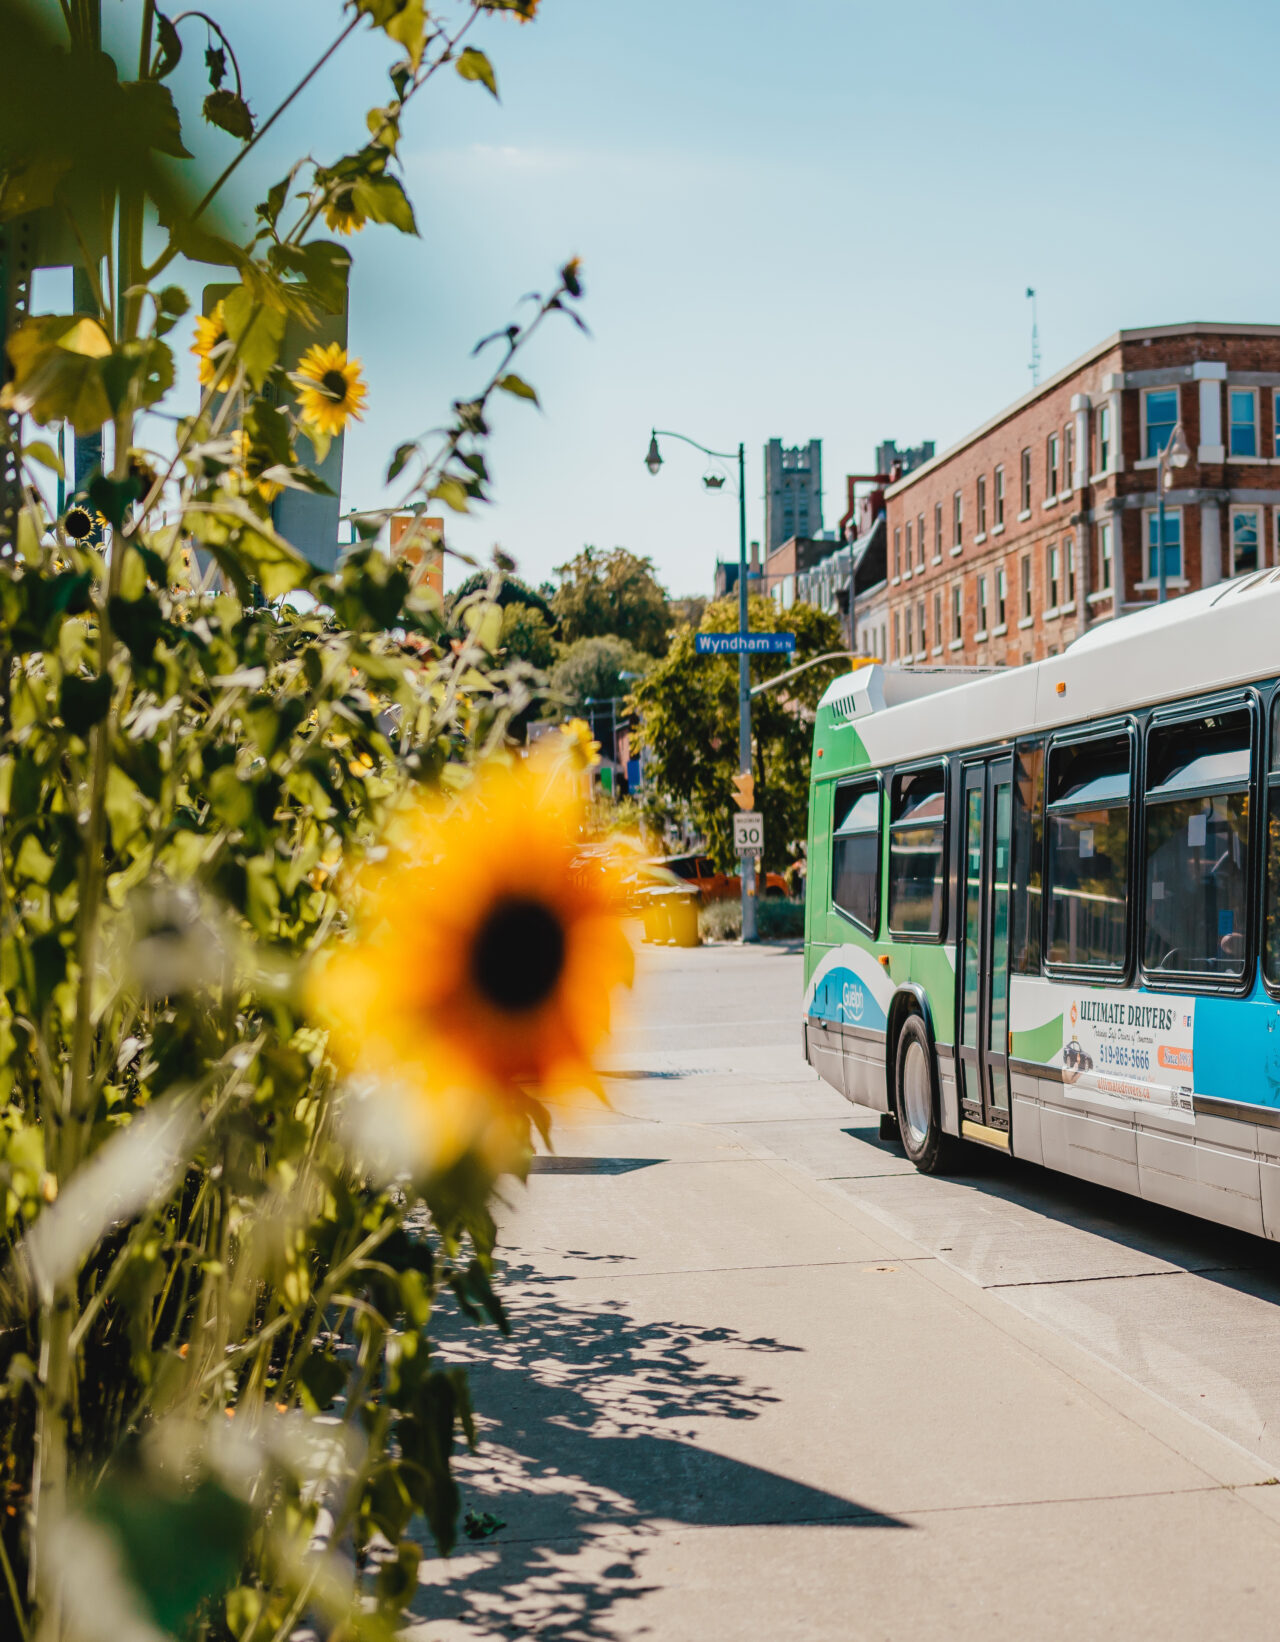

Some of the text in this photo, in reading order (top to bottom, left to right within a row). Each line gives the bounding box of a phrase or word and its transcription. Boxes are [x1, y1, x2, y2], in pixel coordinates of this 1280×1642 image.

[700, 636, 770, 654] Wyndham
[785, 641, 792, 649] N
[738, 828, 760, 844] 30
[1080, 1000, 1125, 1025] ULTIMATE
[1100, 1044, 1150, 1070] 519-265-3666
[1164, 1048, 1178, 1065] Since
